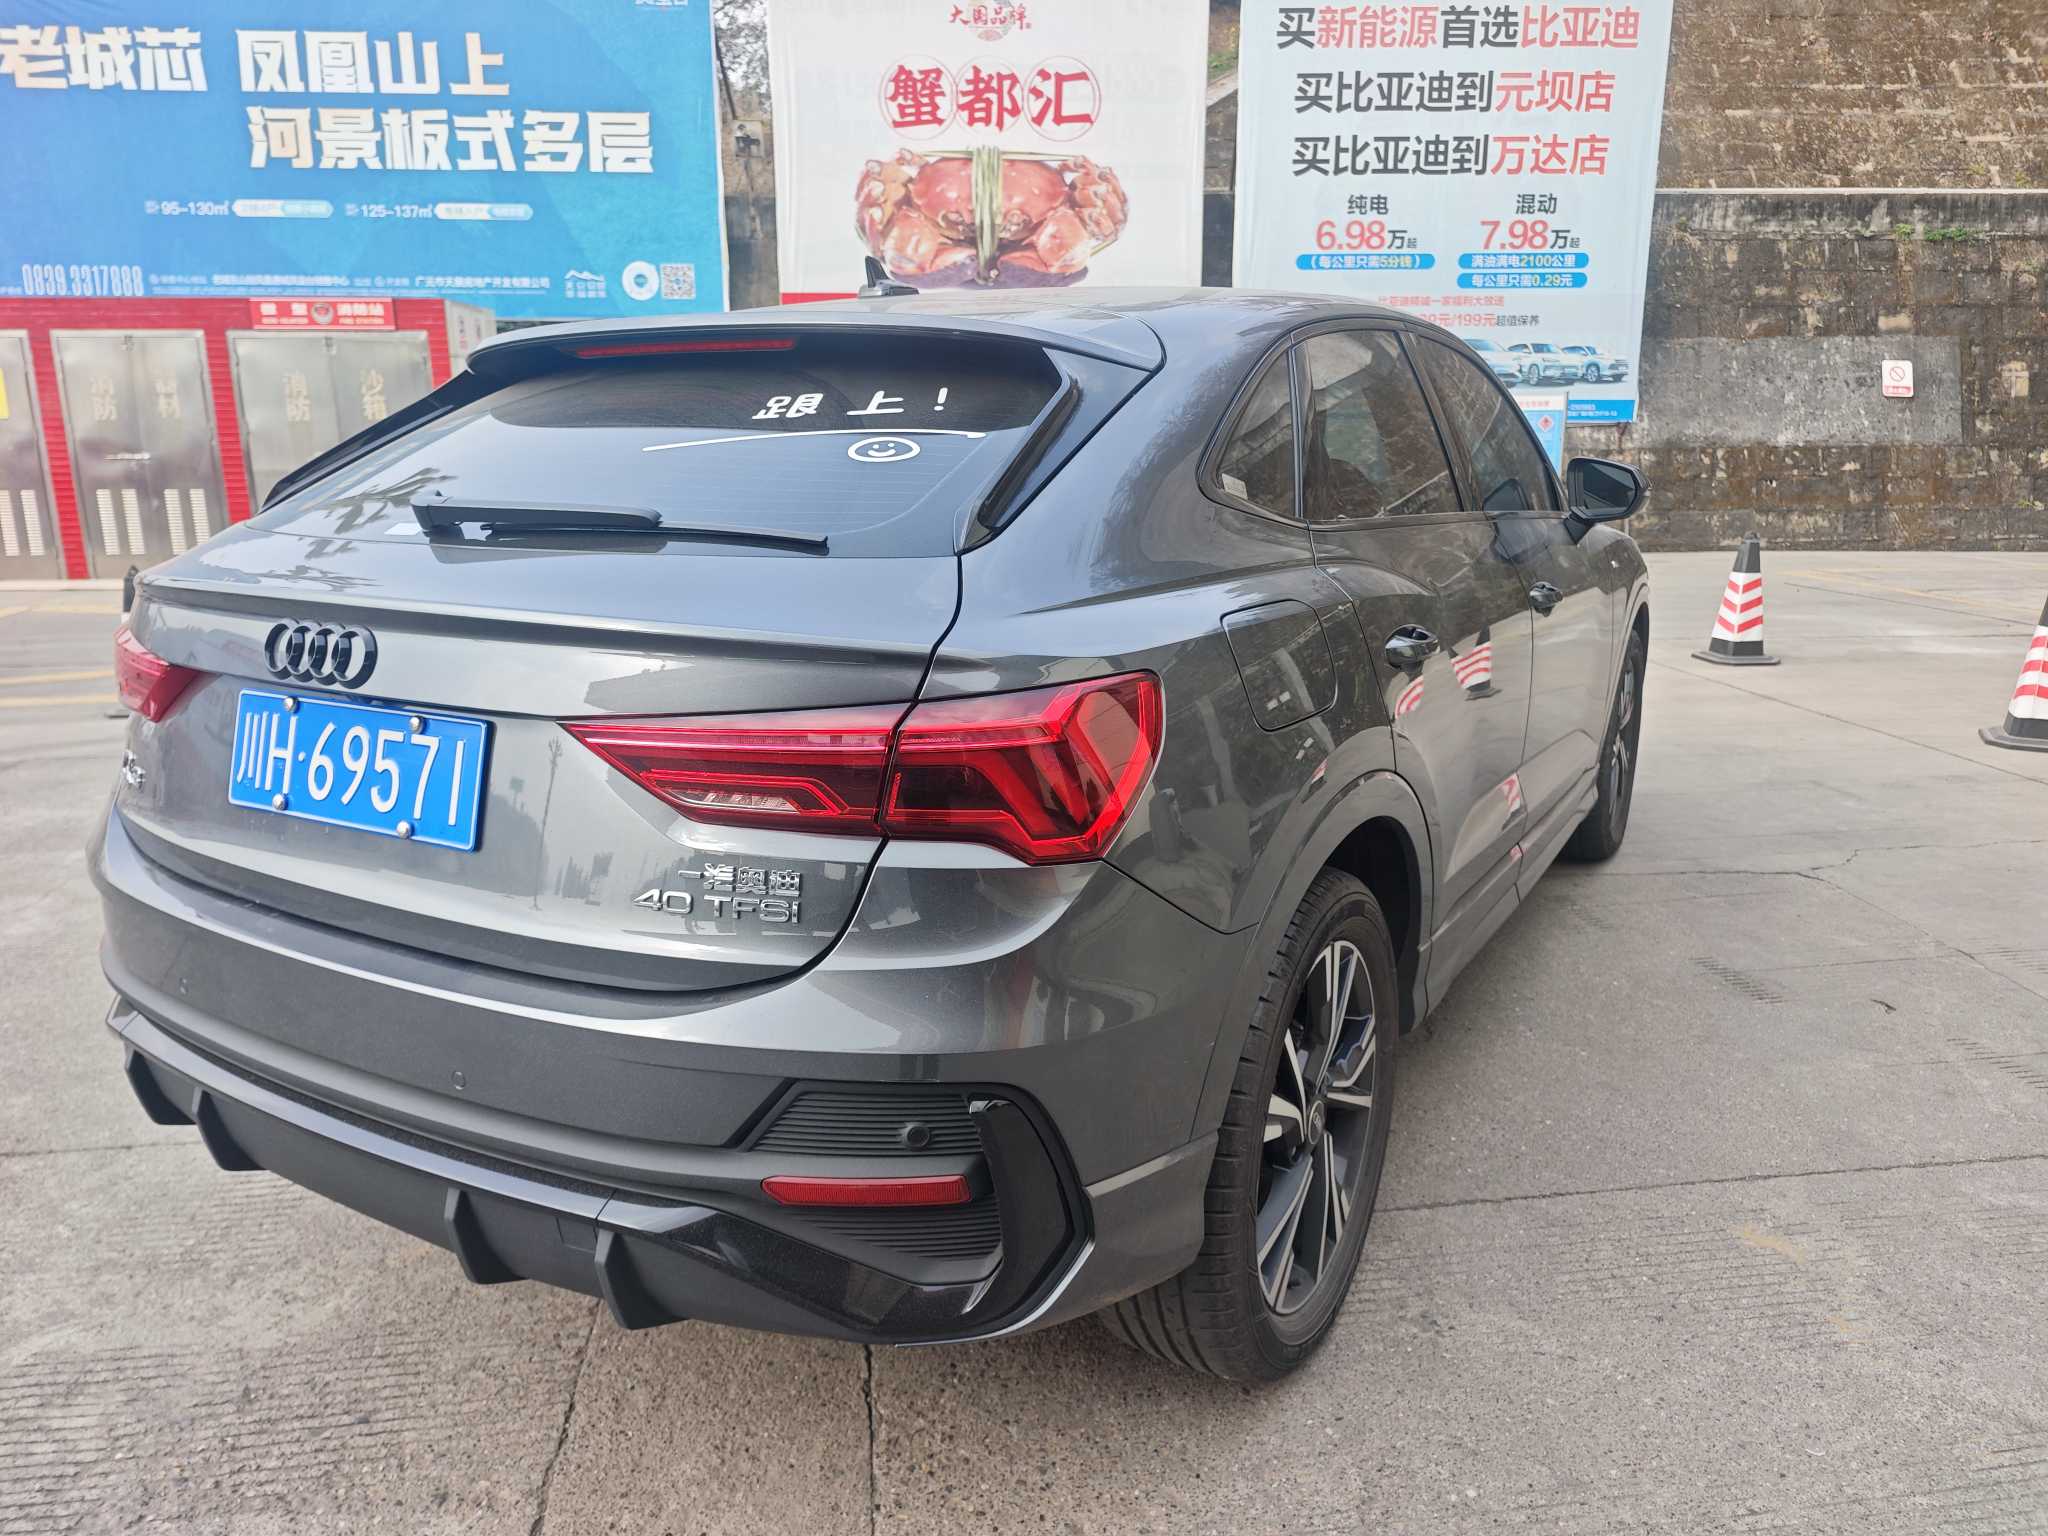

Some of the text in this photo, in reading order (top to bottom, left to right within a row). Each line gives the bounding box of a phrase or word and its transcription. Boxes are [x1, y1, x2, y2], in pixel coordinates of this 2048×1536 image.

[948, 3, 1026, 30] 大国品牌
[1276, 5, 1640, 49] 买新能源首选比亚迪
[0, 26, 510, 96] 老城芯 凤凰山上
[885, 64, 1096, 133] 蟹都汇
[1294, 70, 1617, 114] 买比亚迪到元坝店
[246, 105, 654, 174] 河景板式多层
[1292, 134, 1611, 177] 买比亚迪到万达店
[1347, 194, 1389, 216] 纯电
[1515, 193, 1558, 216] 混动
[236, 711, 465, 826] 川H·69571
[632, 888, 694, 915] 40
